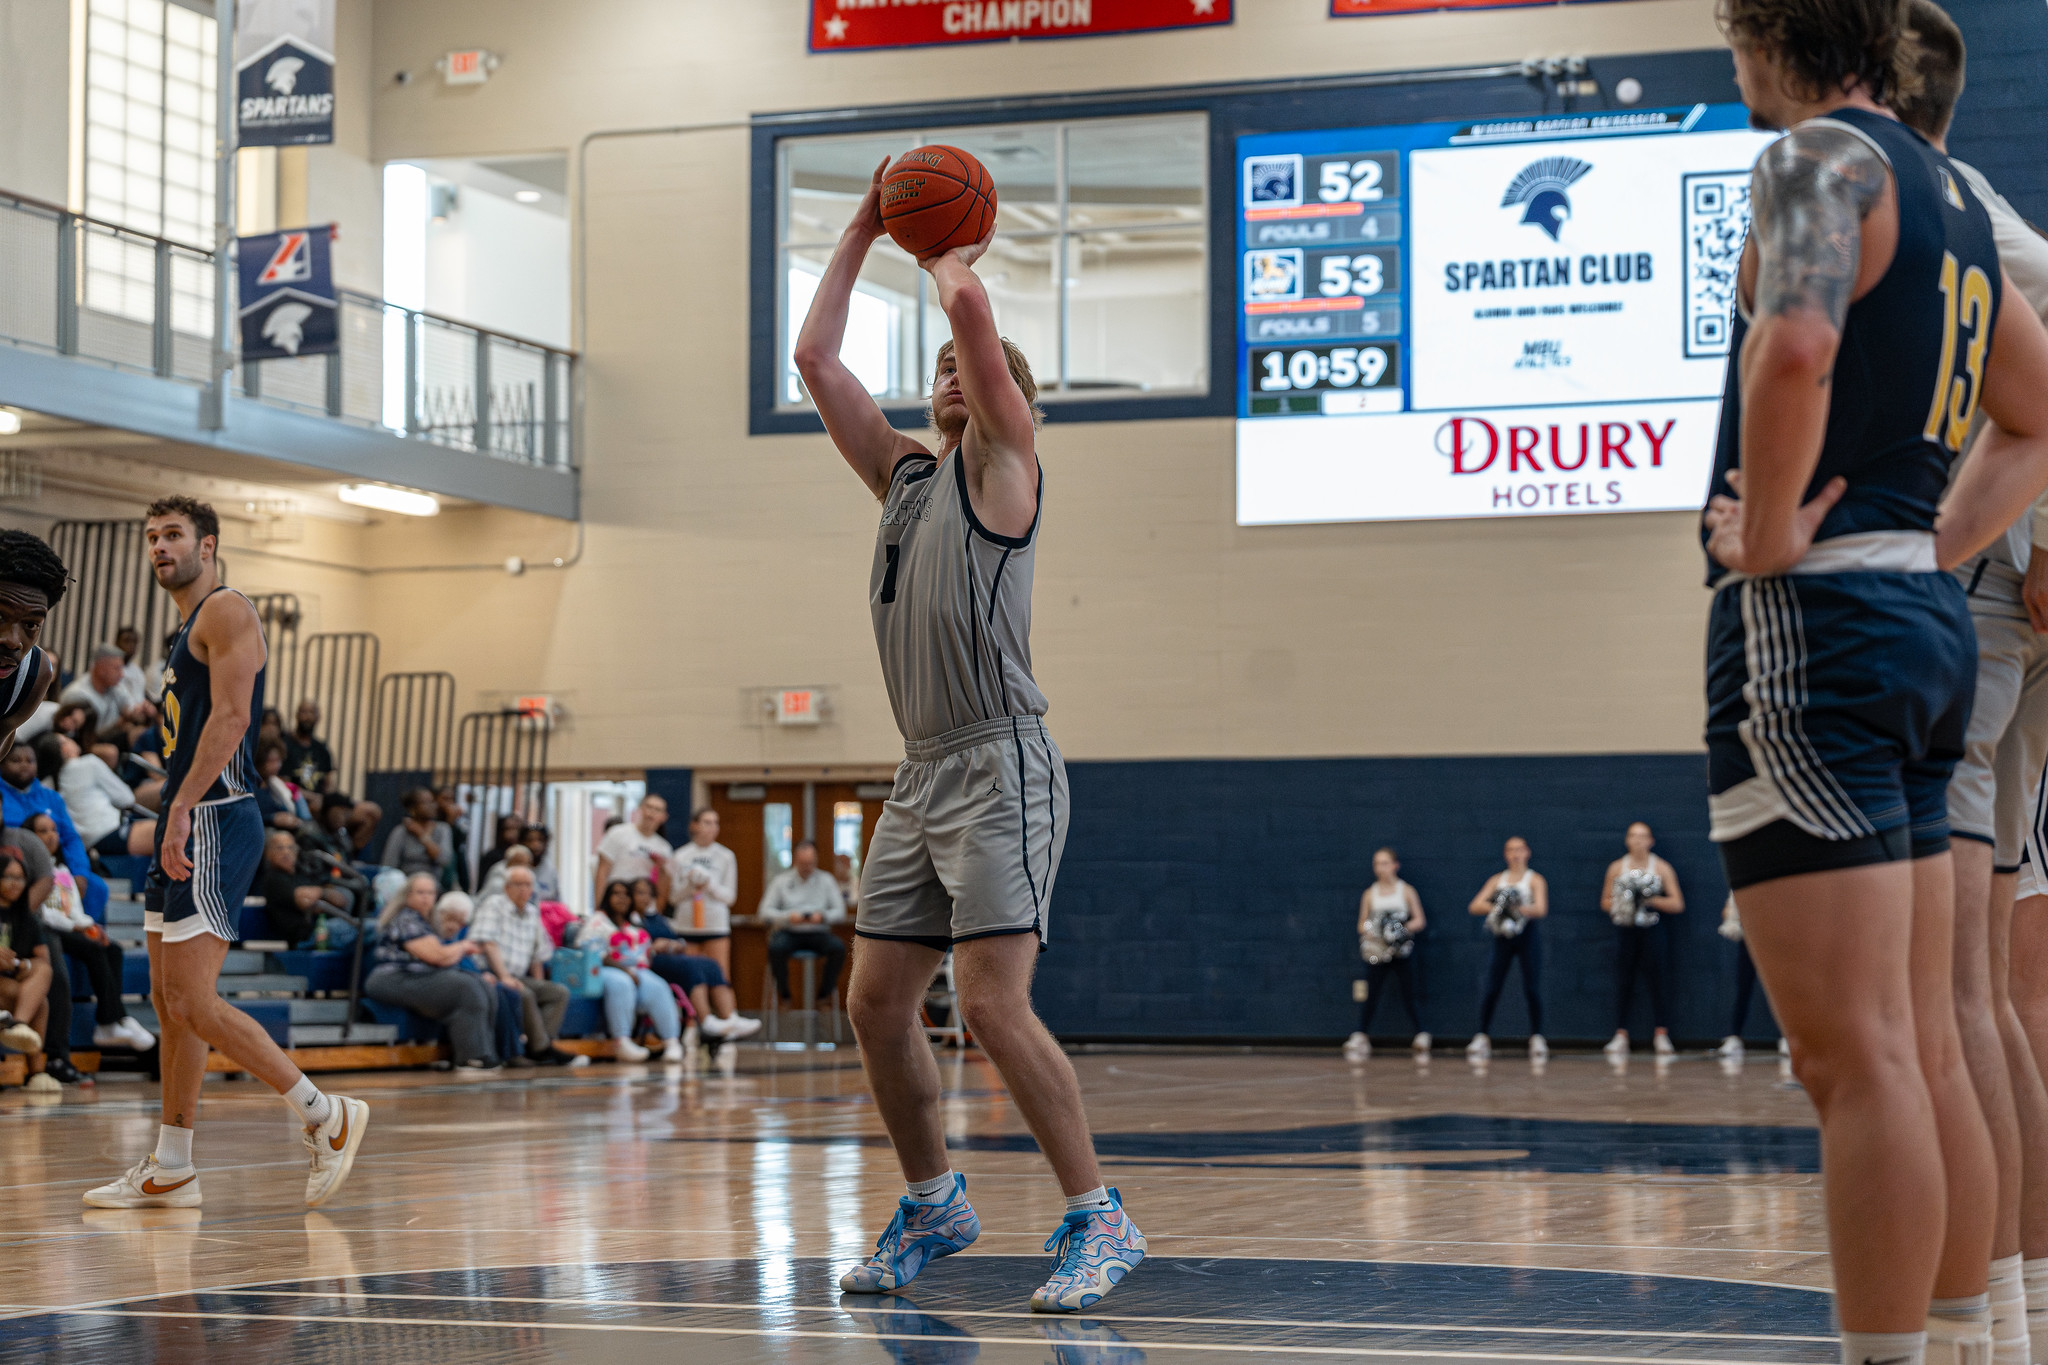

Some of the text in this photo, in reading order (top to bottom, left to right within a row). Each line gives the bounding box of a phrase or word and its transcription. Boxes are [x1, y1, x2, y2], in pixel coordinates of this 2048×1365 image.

[942, 0, 1092, 34] CHAMPION
[240, 93, 334, 120] SPARTANS
[1318, 160, 1384, 202] 52
[1258, 216, 1379, 243] FOULS 4
[1318, 254, 1384, 297] 53
[1445, 252, 1653, 292] SPARTAN CLUB
[1258, 310, 1380, 337] FOULS 5
[1260, 346, 1388, 391] 10:59
[1922, 249, 1993, 452] 13
[1434, 416, 1677, 475] DRURY
[1492, 481, 1622, 508] HOTELS
